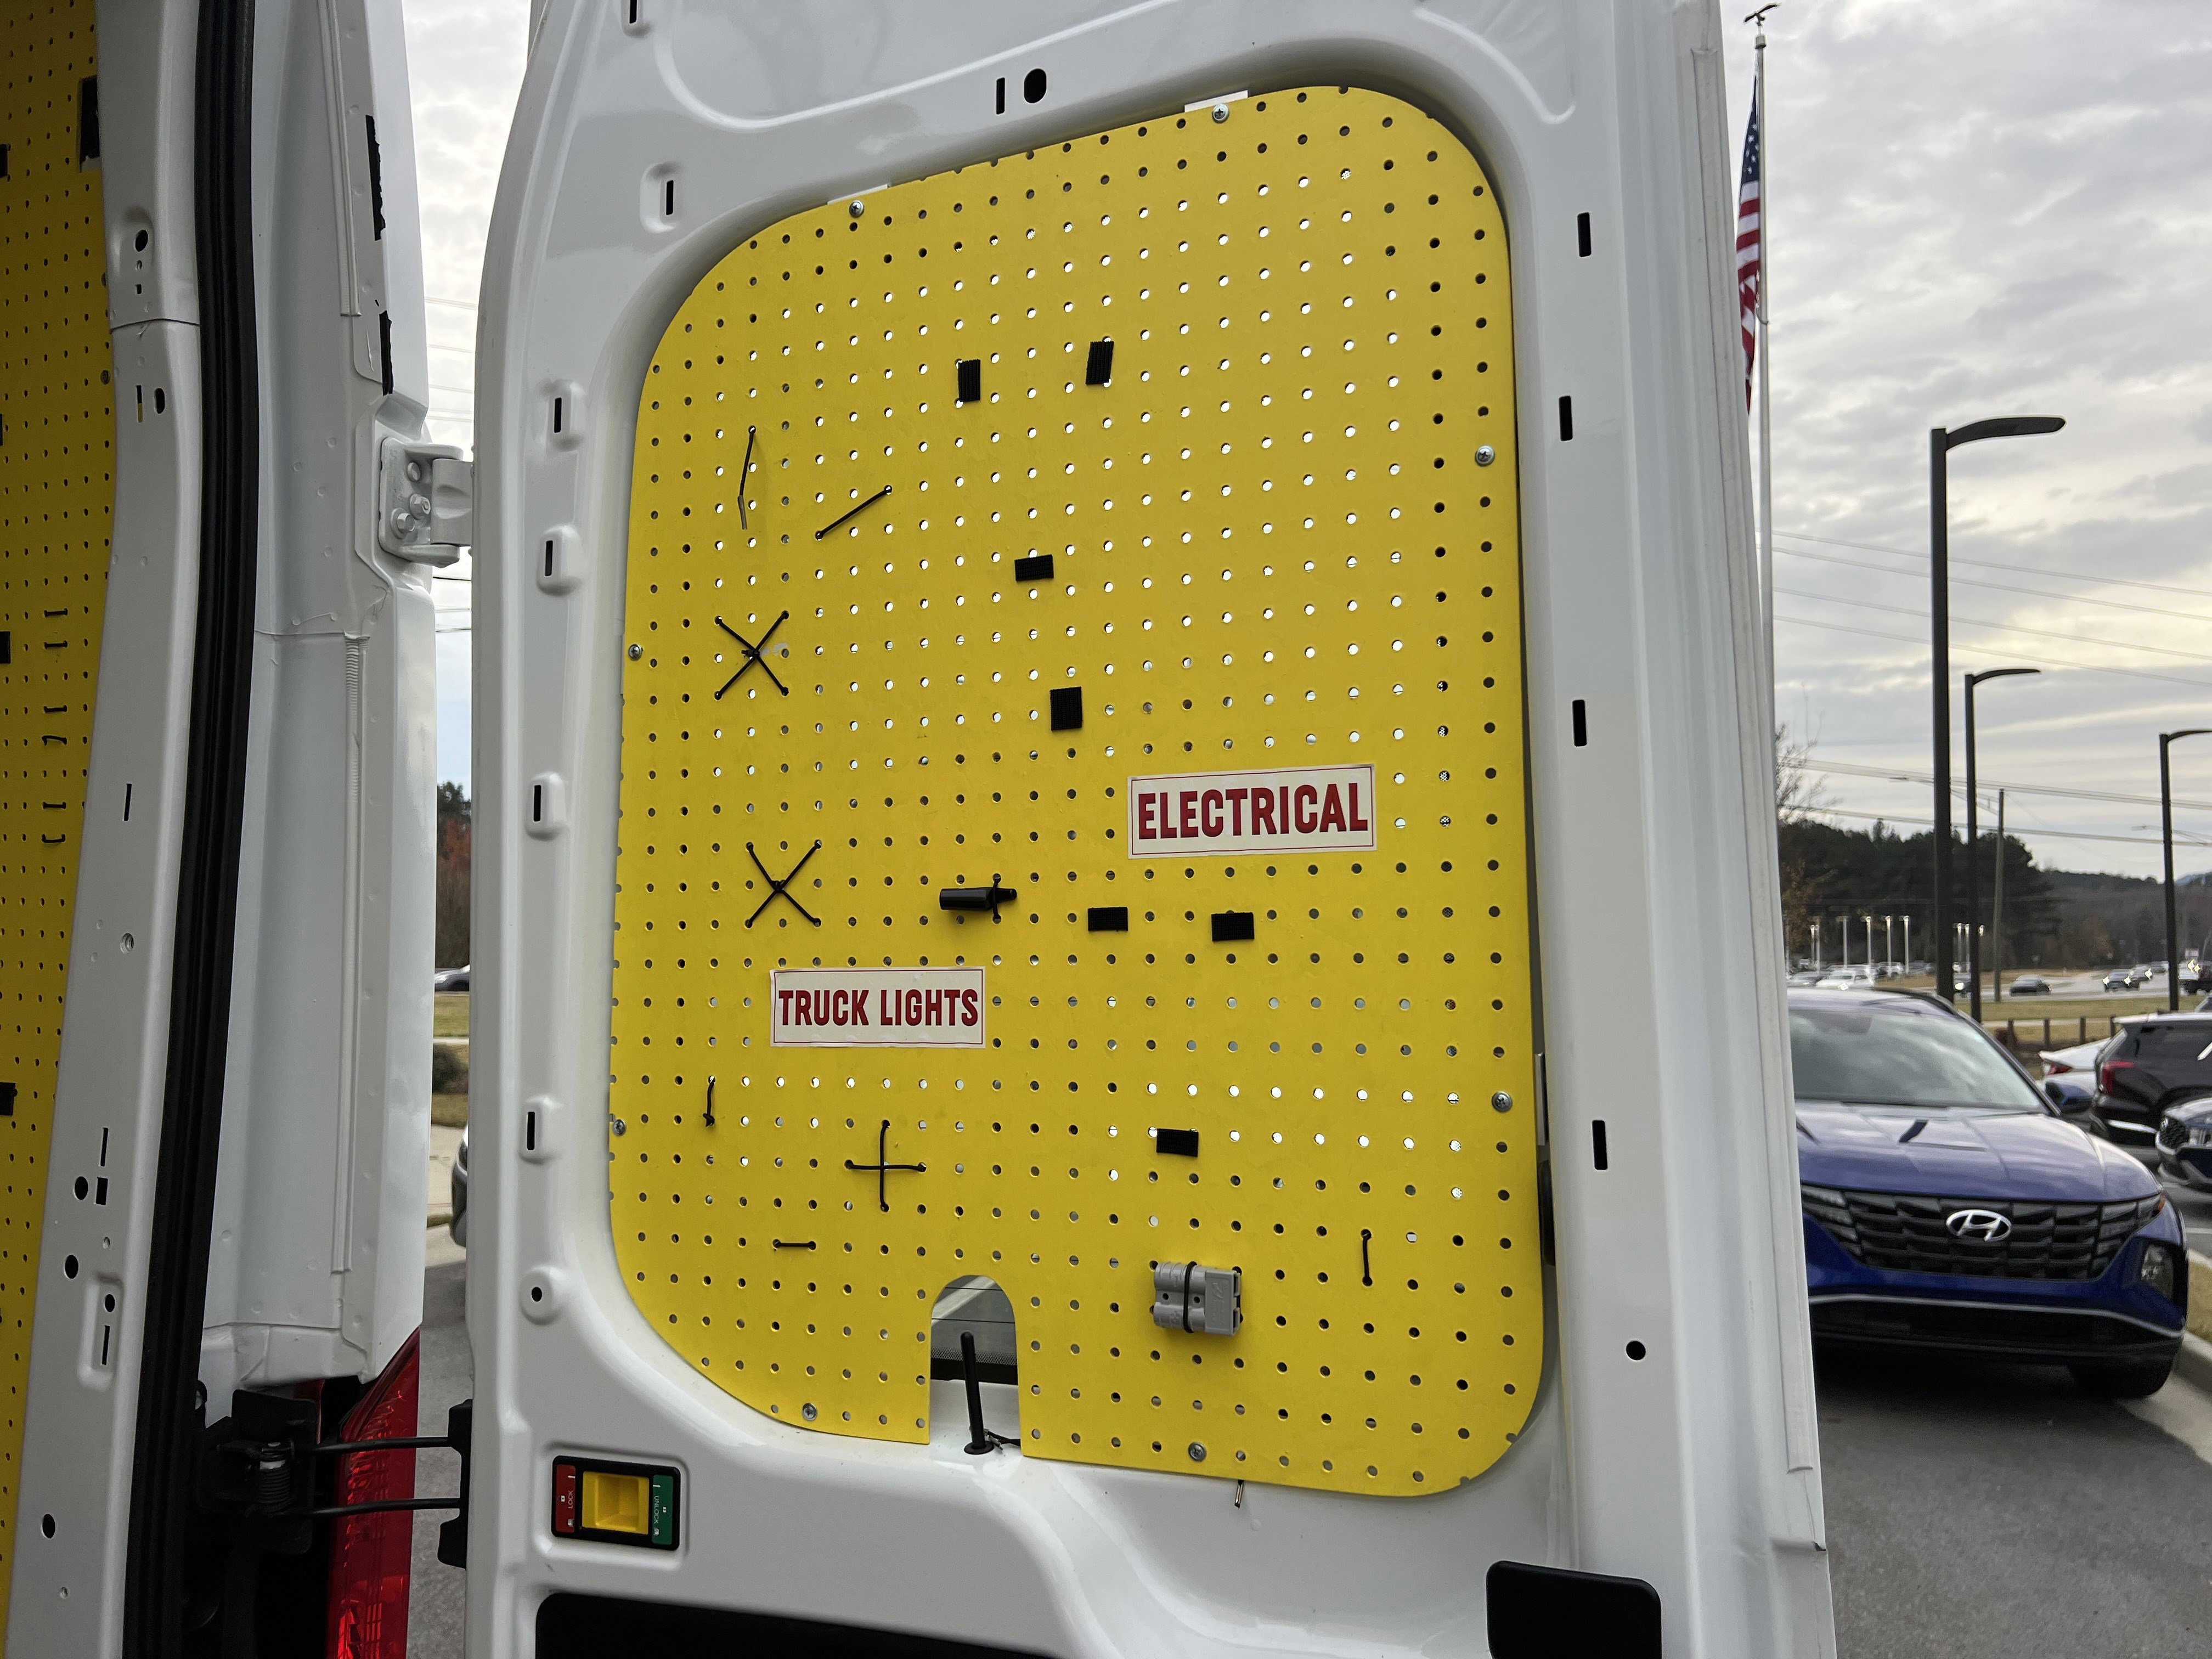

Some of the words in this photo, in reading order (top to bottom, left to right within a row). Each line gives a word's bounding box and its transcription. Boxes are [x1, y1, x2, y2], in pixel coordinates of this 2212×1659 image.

[1138, 782, 1369, 840] ELECTRICAL
[778, 989, 870, 1026] TRUCK
[880, 988, 979, 1027] LIGHTS
